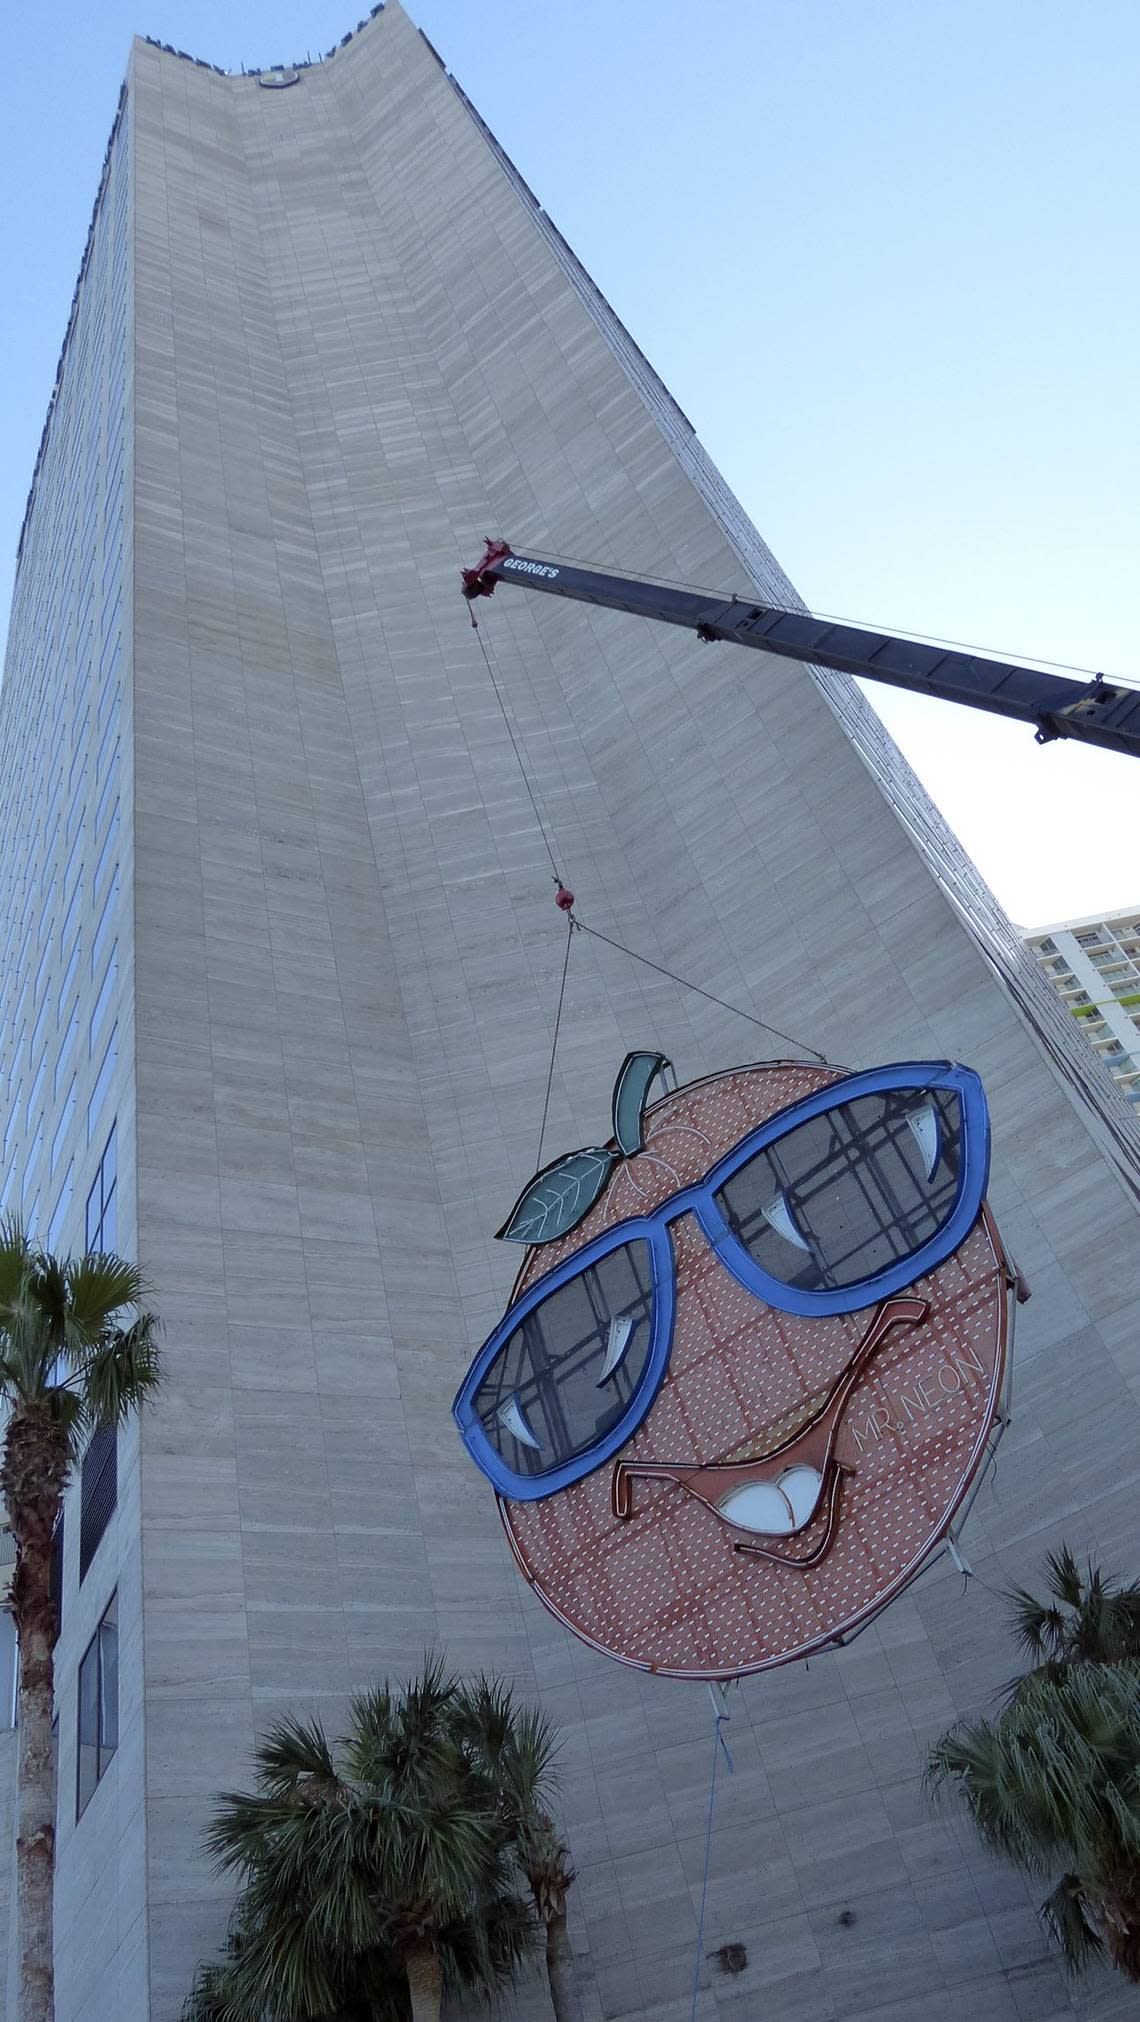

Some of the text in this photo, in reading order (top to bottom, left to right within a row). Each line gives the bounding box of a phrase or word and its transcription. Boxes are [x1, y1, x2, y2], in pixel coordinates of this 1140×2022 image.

[503, 558, 560, 579] GEORGE'S
[851, 1347, 985, 1452] MR. NEON
